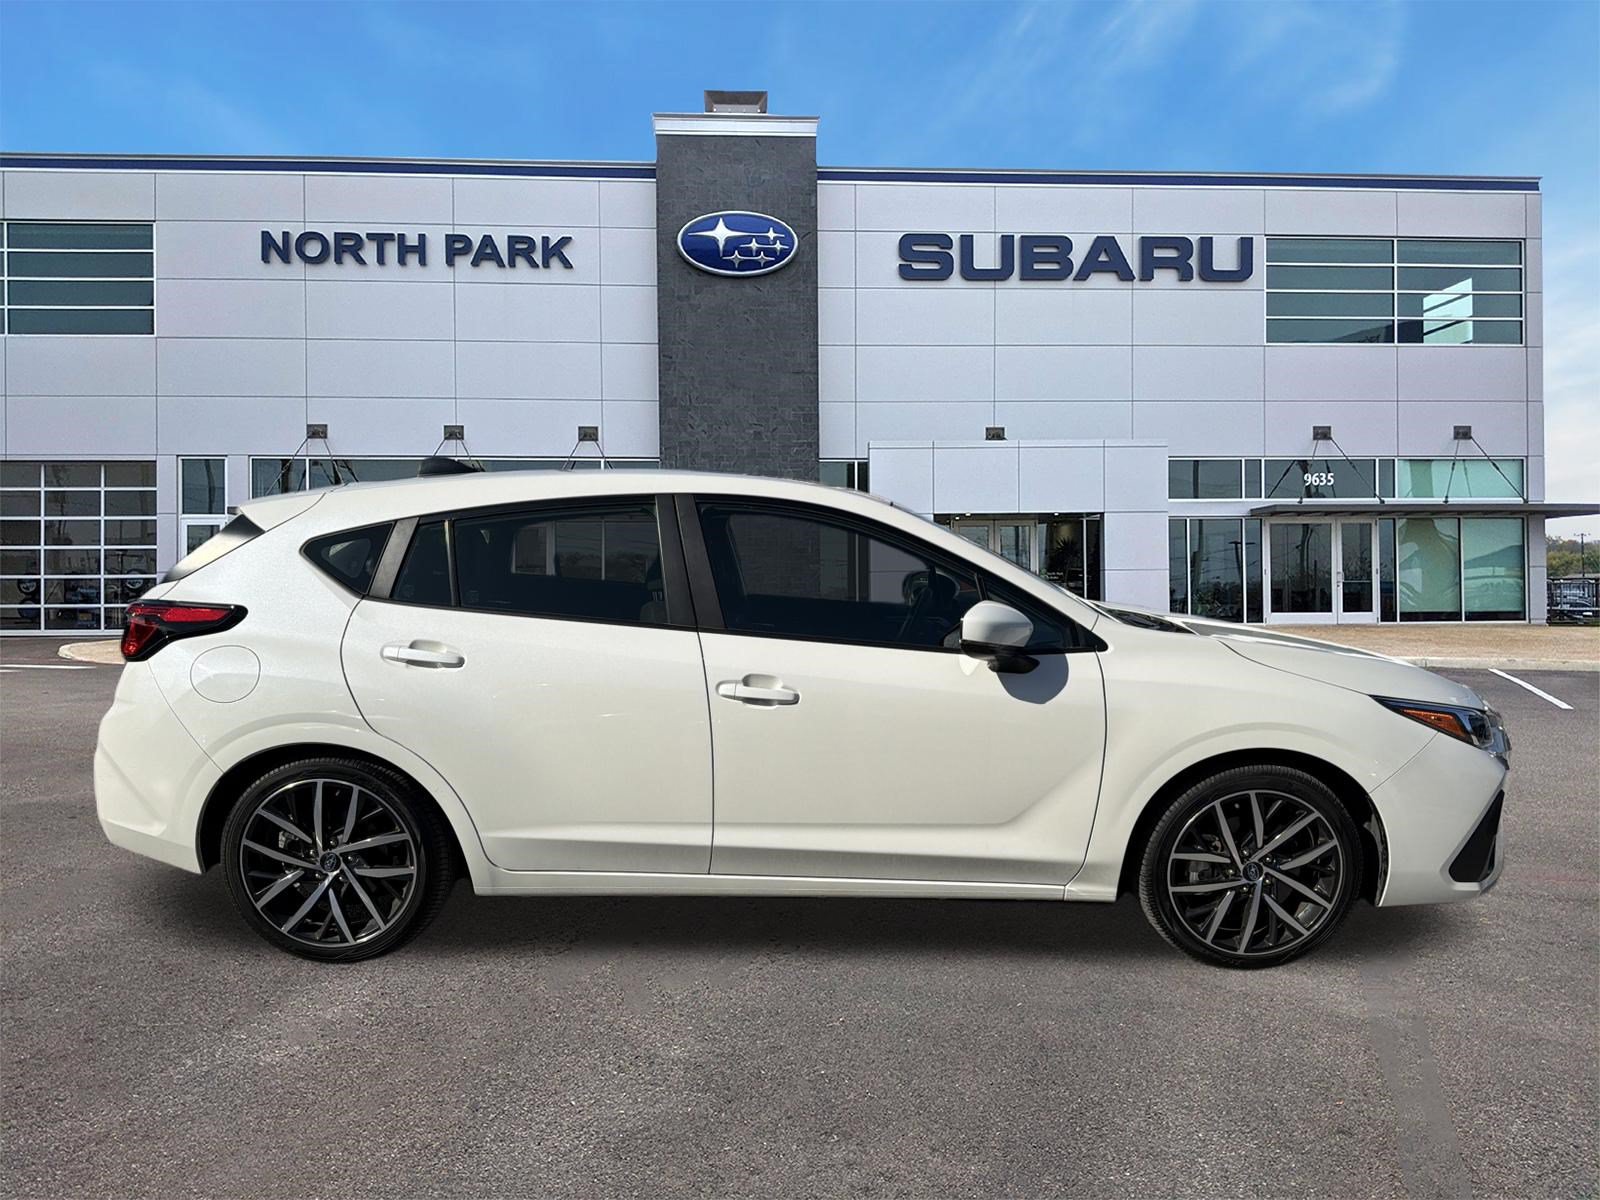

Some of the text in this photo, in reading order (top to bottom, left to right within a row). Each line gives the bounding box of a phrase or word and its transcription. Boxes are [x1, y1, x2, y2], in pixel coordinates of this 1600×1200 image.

[260, 230, 574, 269] NORTH PARK
[898, 232, 1254, 282] SUBARU
[1303, 472, 1335, 486] 9635
